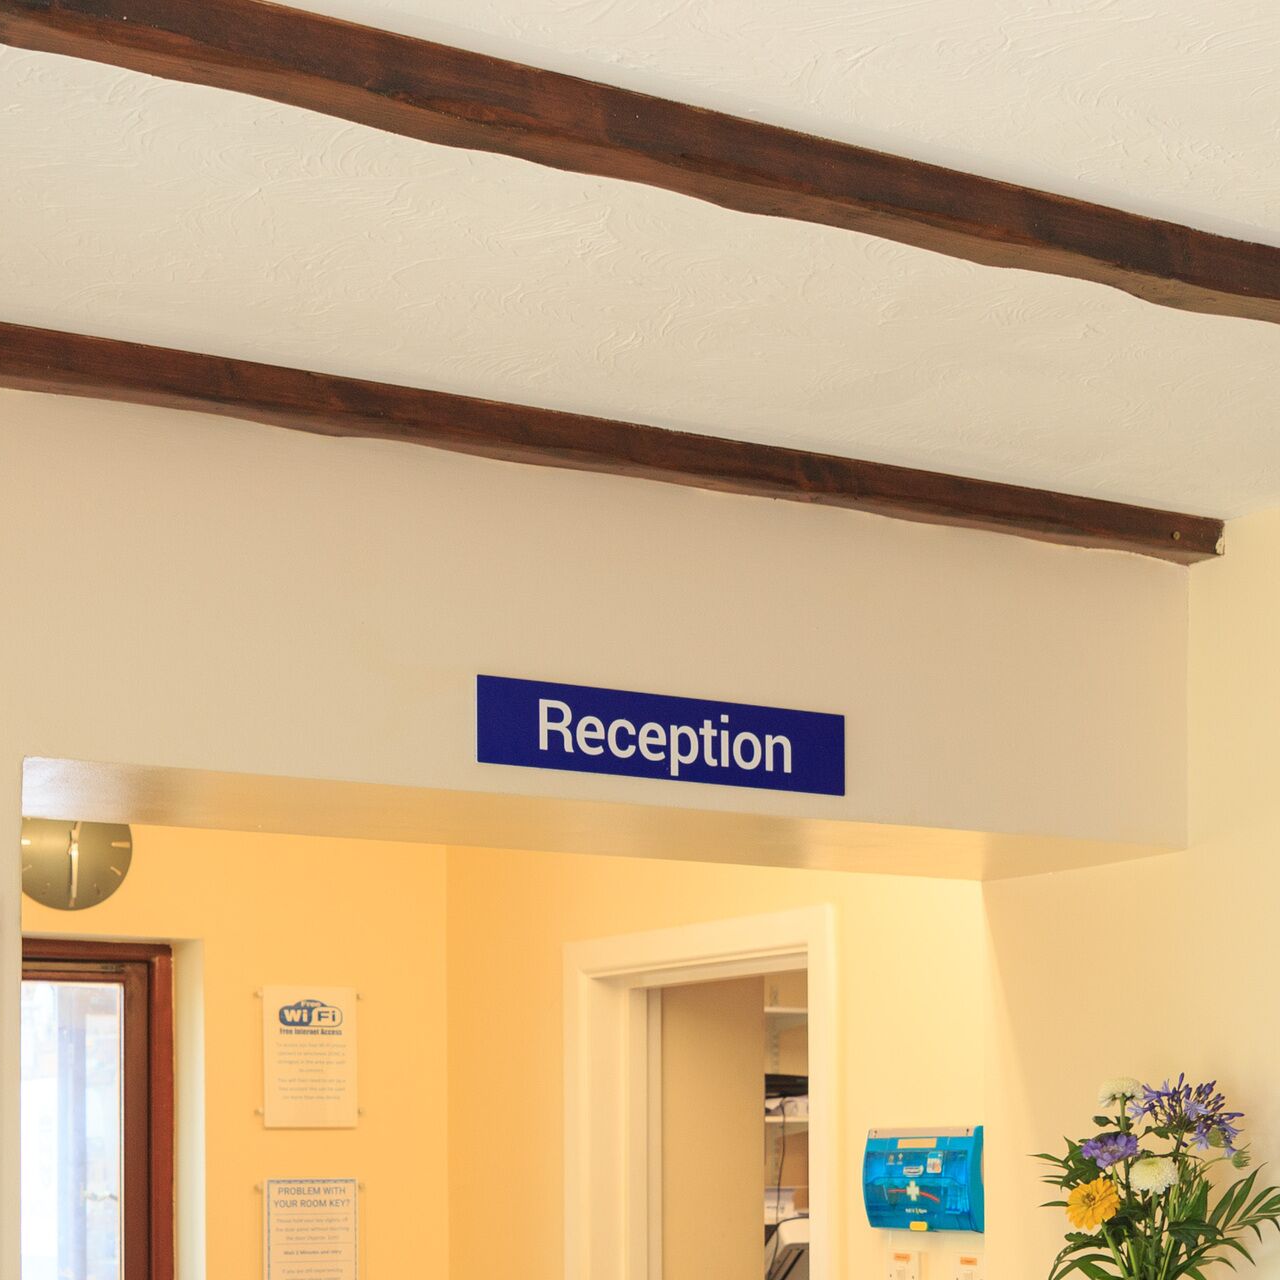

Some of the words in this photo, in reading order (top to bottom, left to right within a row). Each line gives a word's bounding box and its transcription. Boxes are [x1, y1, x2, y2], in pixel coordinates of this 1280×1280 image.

[538, 698, 792, 777] Reception
[278, 1187, 320, 1195] PROBLEM
[323, 1187, 346, 1195] WITH
[273, 1200, 298, 1208] YOUR
[300, 1199, 327, 1208] ROOM
[329, 1199, 350, 1207] KEY?
